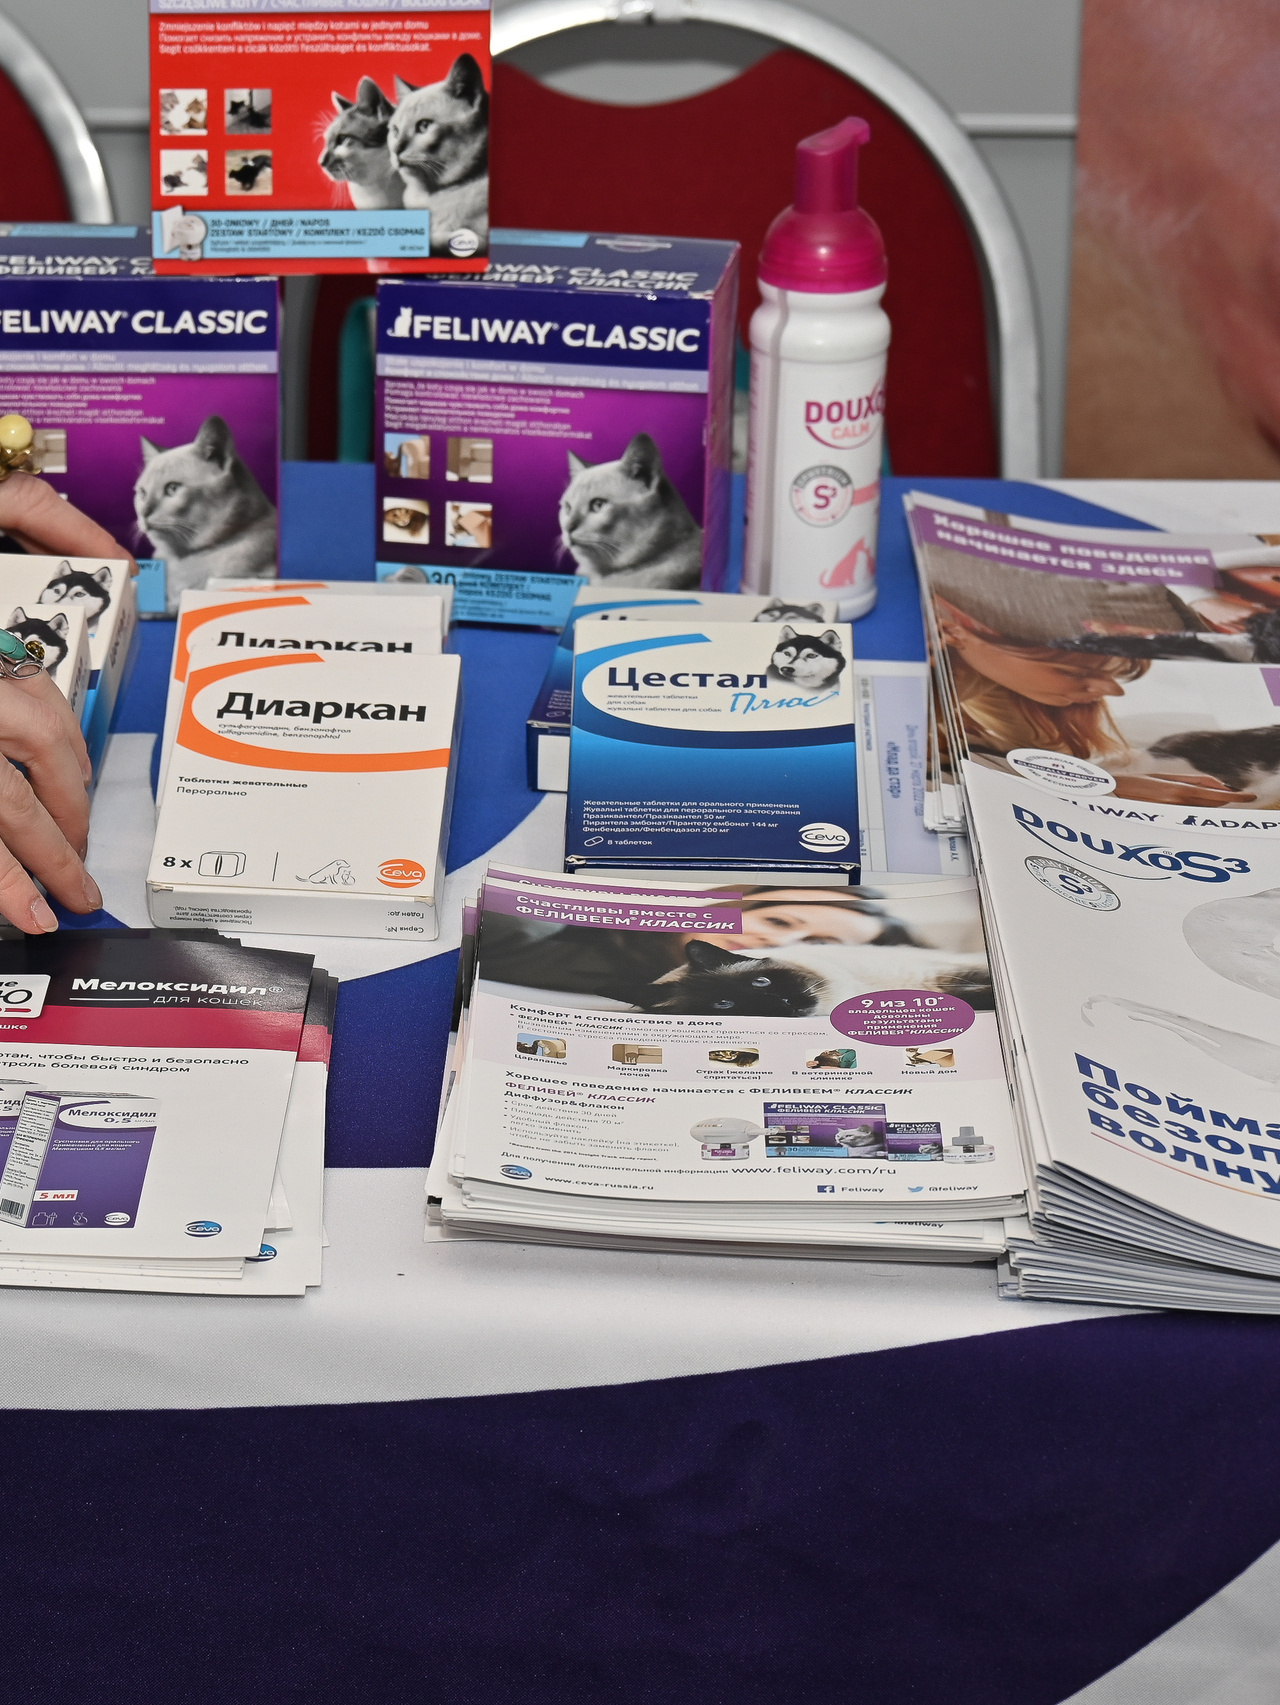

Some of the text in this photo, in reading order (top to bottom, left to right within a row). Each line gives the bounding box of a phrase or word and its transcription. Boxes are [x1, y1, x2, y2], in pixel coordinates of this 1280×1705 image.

[569, 266, 699, 281] CLASSIC
[568, 275, 696, 291] КЛАССИК
[131, 310, 268, 334] CLASSIC
[562, 323, 700, 352] CLASSIC
[831, 422, 870, 440] CALM
[932, 513, 1209, 565] Хорошее поведение
[937, 529, 1184, 578] начинается здесь
[608, 667, 767, 691] Цестал
[216, 692, 426, 724] Диаркан
[729, 691, 840, 714] Плюс
[178, 776, 308, 788] Таблетки жевательные
[176, 786, 247, 797] Перорально
[681, 807, 742, 815] перорального
[699, 801, 744, 809] орального
[582, 826, 701, 834] Фенбендазол/Фенбендазол
[631, 820, 712, 828] эмбонат/Пірантелу
[1200, 819, 1280, 830] ADAP
[516, 894, 697, 919] Счастливы вместе
[387, 910, 424, 919] Годен до:
[400, 925, 424, 933] Серия
[638, 919, 735, 930] КЛАССИК
[153, 996, 264, 1006] для кошек
[861, 1000, 874, 1008] 9
[880, 1000, 906, 1008] из
[510, 1003, 570, 1018] Комфорт
[585, 1015, 673, 1026] спокойствие
[909, 1027, 964, 1035] КЛАССИК
[38, 1053, 86, 1061] чтобы
[90, 1055, 147, 1064] быстро
[165, 1057, 249, 1065] безопасно
[514, 1053, 568, 1066] Царапанье
[51, 1061, 117, 1070] болевой
[122, 1064, 191, 1073] синдром
[607, 1065, 668, 1074] Маркировка
[696, 1068, 725, 1076] Страх
[505, 1070, 568, 1086] Хорошее
[572, 1081, 648, 1094] поведение
[652, 1086, 734, 1095] начинается
[504, 1090, 625, 1110] Диффузор&флакон
[588, 1093, 657, 1103] КЛАССИК
[68, 1109, 157, 1119] Мелоксидил
[501, 1152, 521, 1160] Для
[523, 1156, 576, 1167] получения
[578, 1164, 661, 1174] дополнительной
[731, 1166, 896, 1175] www.feliway.com/ru
[545, 1176, 654, 1191] www.ceva-russia.ru
[929, 1185, 978, 1193] @feliway
[841, 1186, 884, 1194] Feliway
